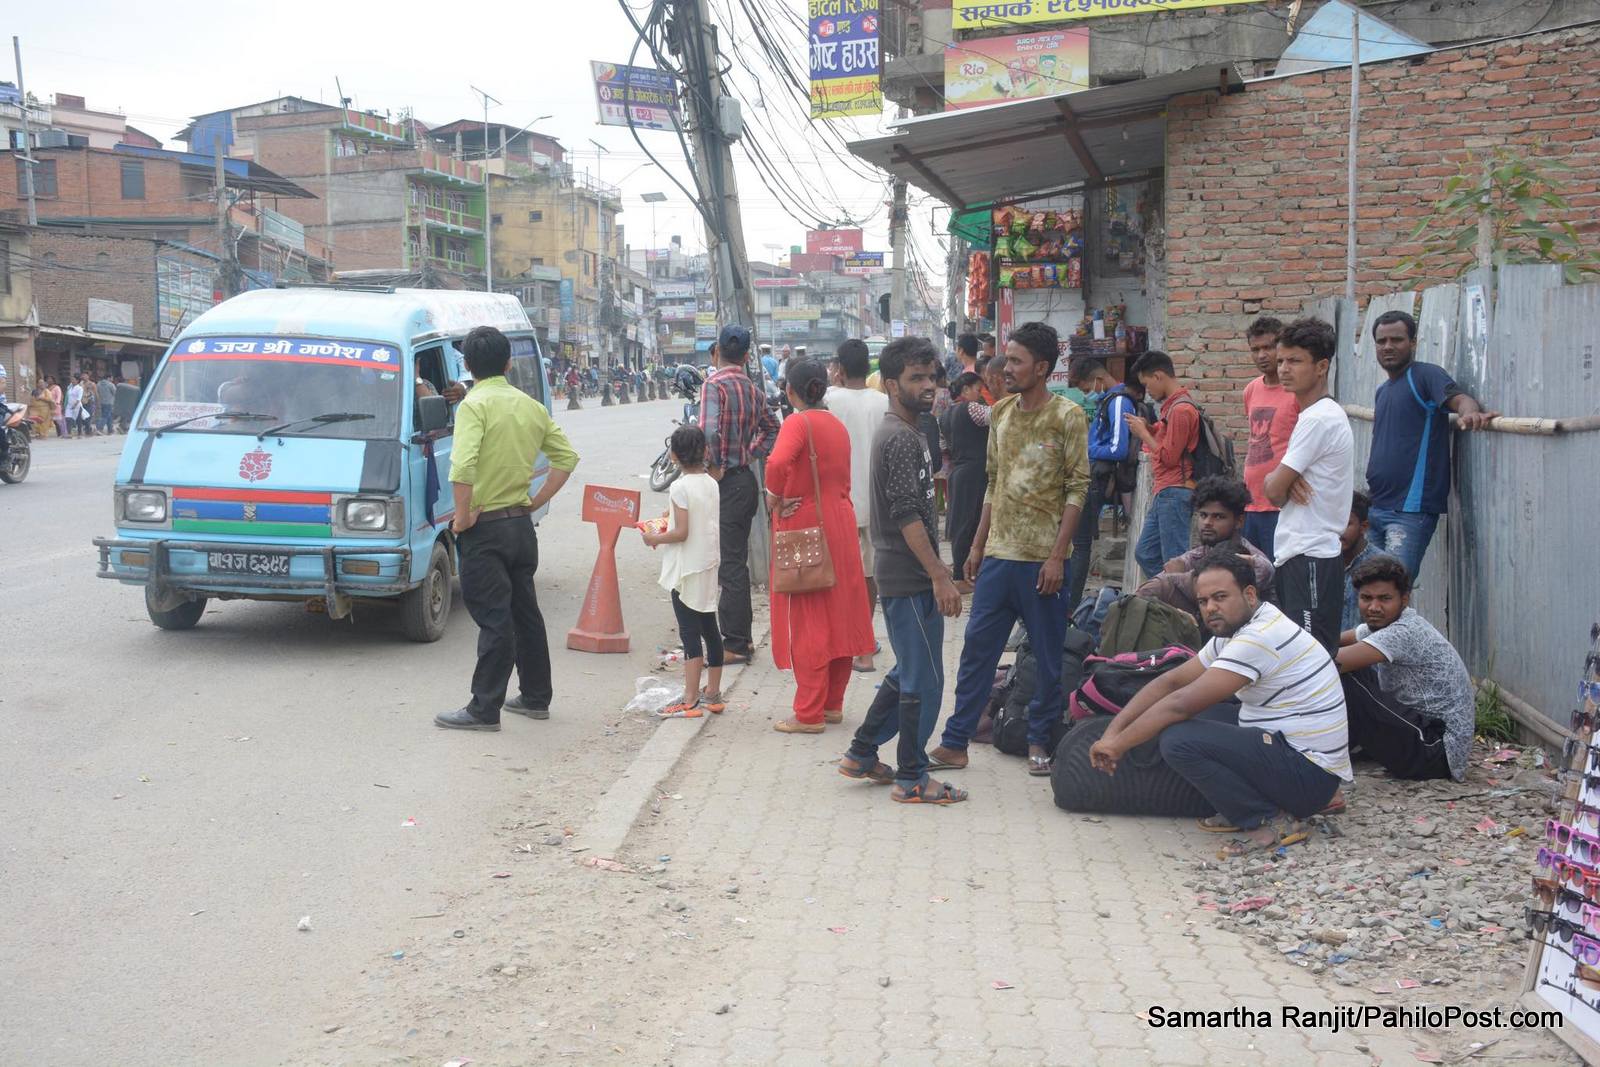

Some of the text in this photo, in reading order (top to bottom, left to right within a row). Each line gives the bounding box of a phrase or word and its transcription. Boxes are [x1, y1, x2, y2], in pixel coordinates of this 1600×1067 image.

[841, 38, 879, 72] हाउस
[963, 63, 985, 76] Rio
[213, 340, 365, 360] जय श्री गणेश
